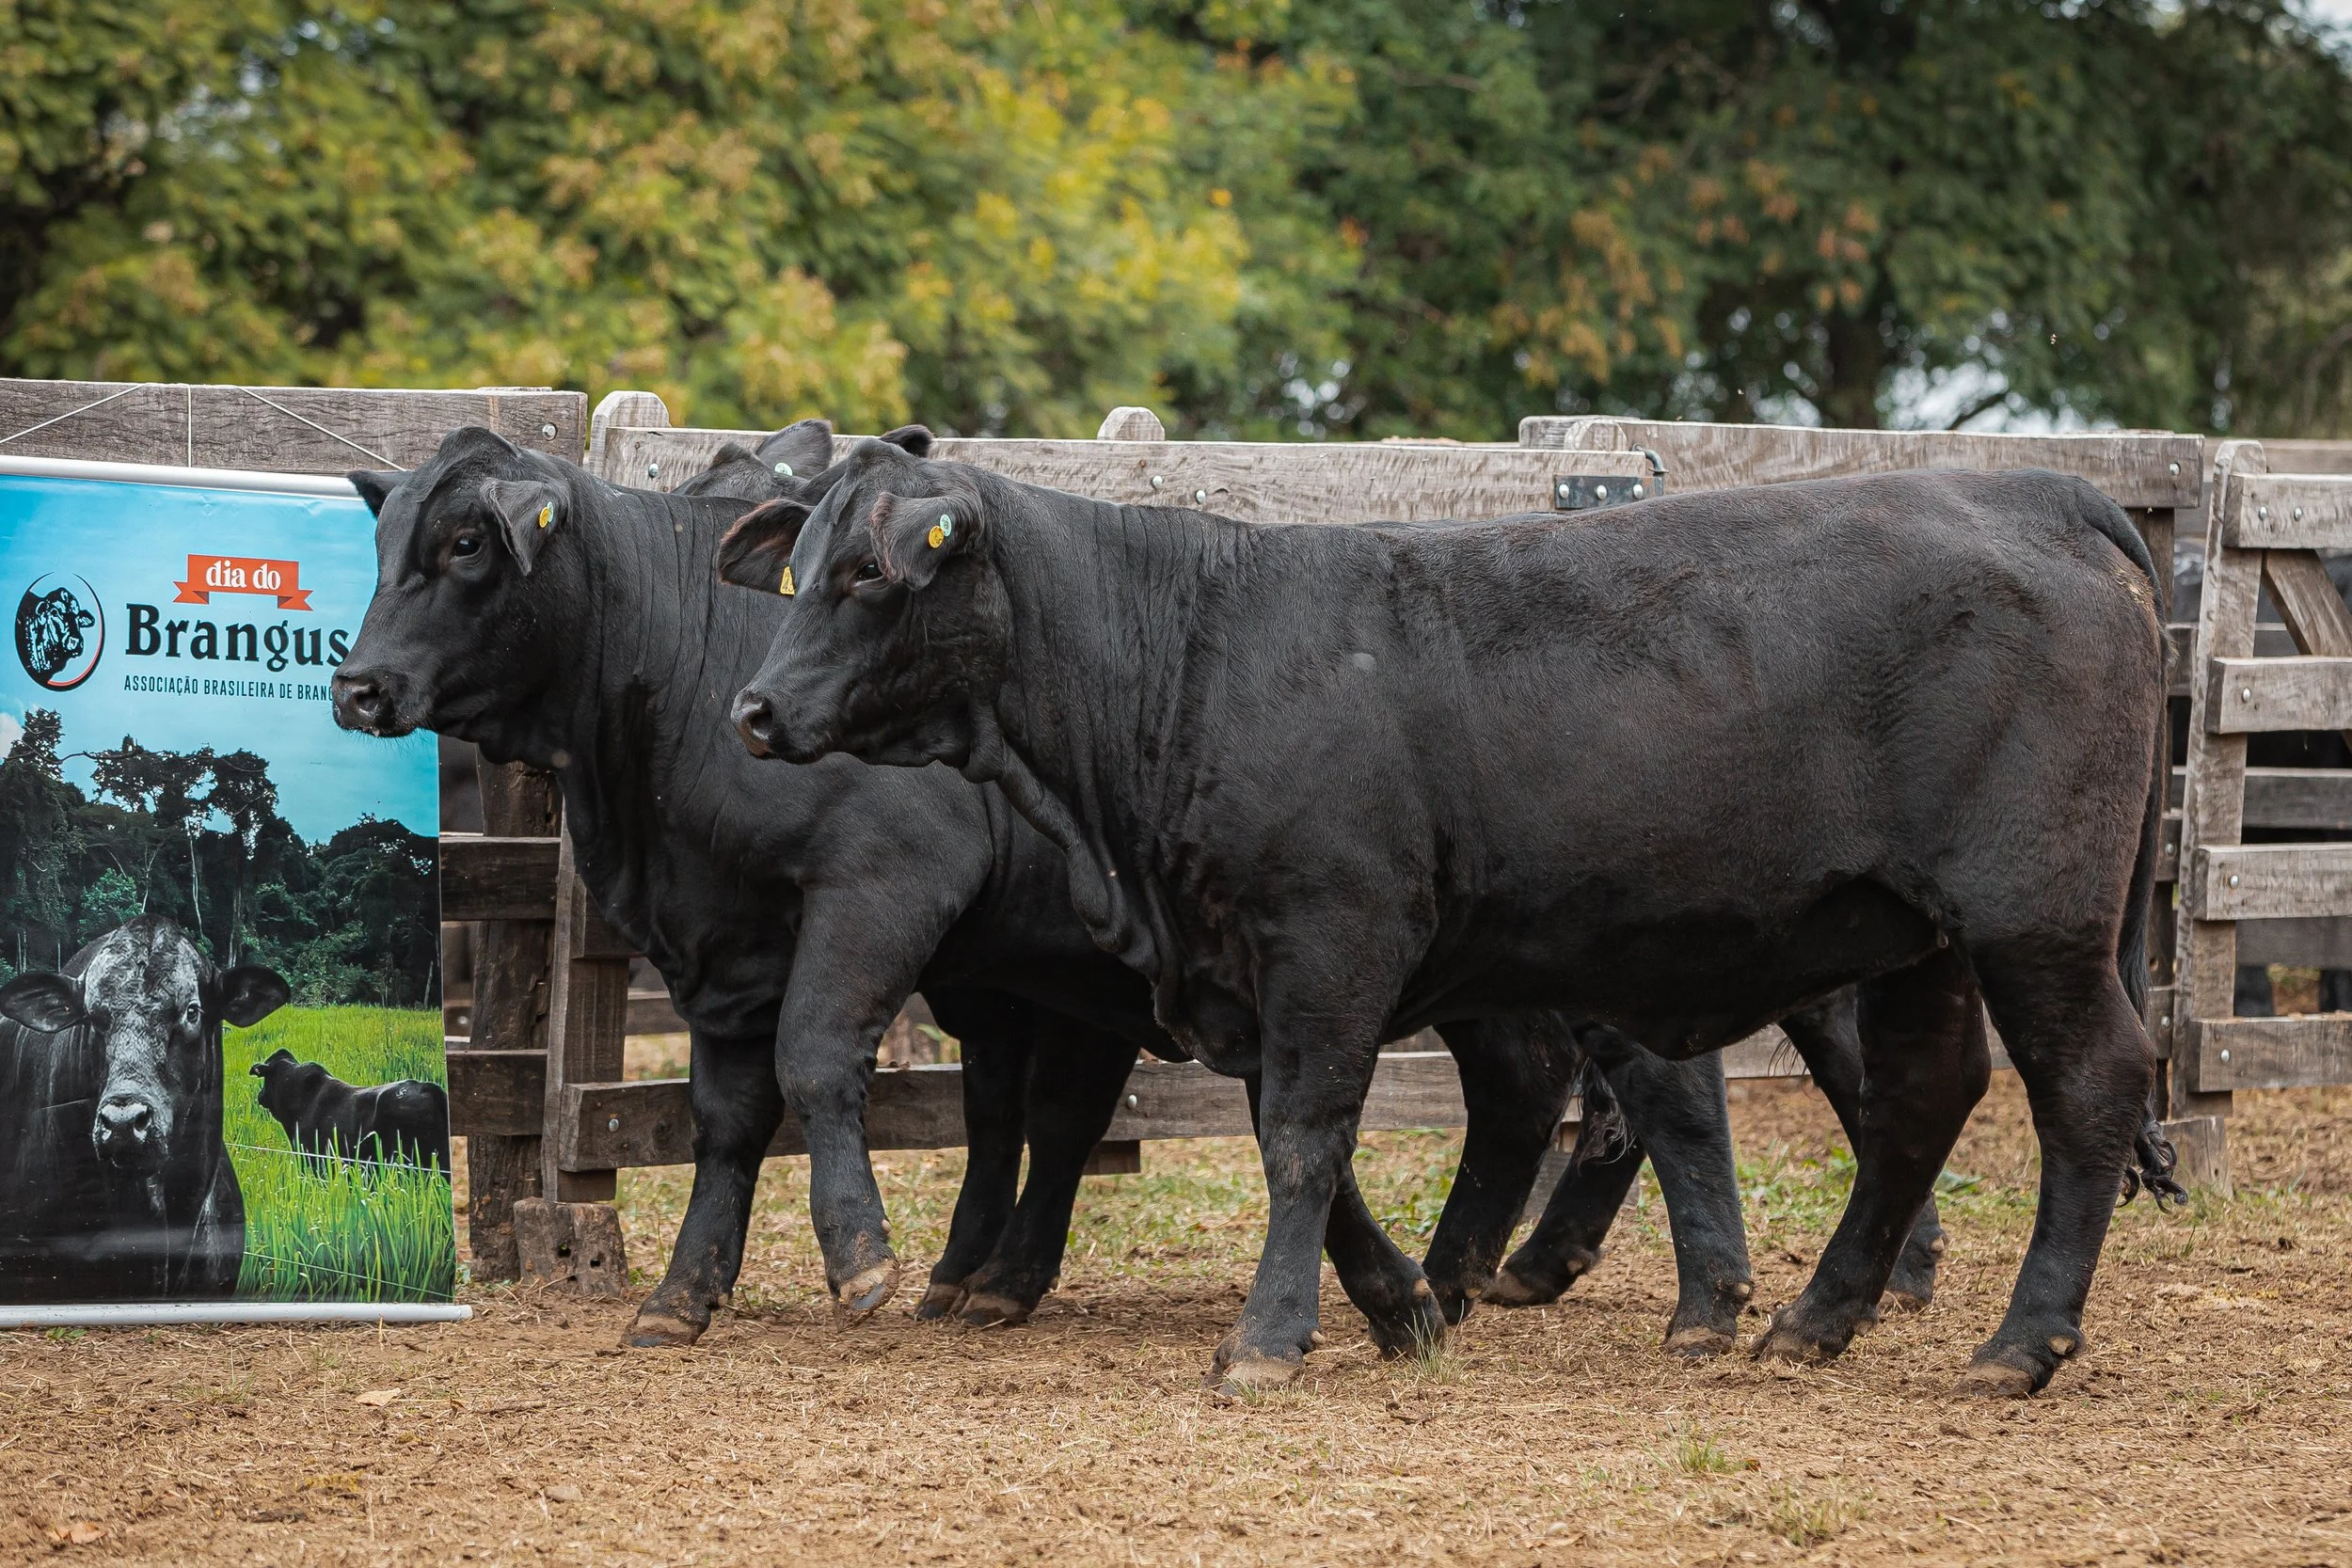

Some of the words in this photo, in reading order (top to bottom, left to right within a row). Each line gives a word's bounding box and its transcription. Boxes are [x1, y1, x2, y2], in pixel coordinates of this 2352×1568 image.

[206, 560, 246, 588] dia
[253, 562, 281, 591] do
[125, 603, 349, 673] Brangus
[124, 674, 198, 696] ASSOCIAÇÃO
[204, 679, 275, 698] BRASILEIRA
[279, 683, 293, 699] DE
